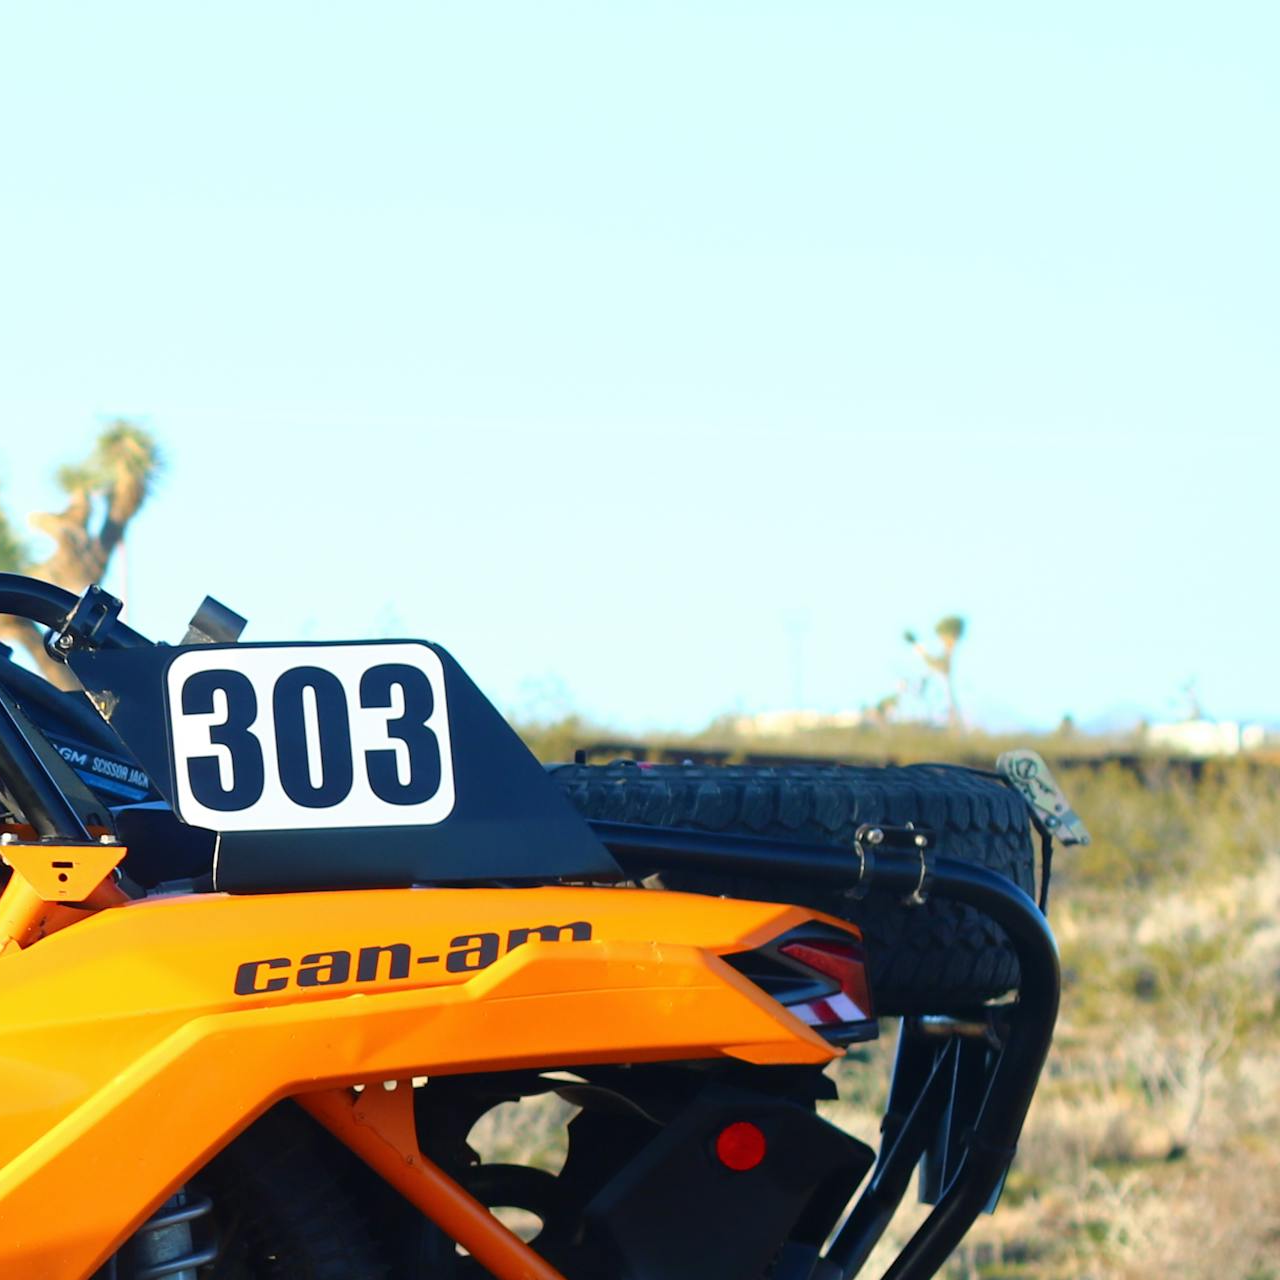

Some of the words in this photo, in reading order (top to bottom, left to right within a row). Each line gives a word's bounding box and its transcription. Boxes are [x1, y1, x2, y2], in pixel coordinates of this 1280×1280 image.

[53, 743, 88, 766] GM
[91, 757, 129, 781] SCISSOR
[179, 661, 439, 813] 303
[234, 921, 592, 996] can-am
